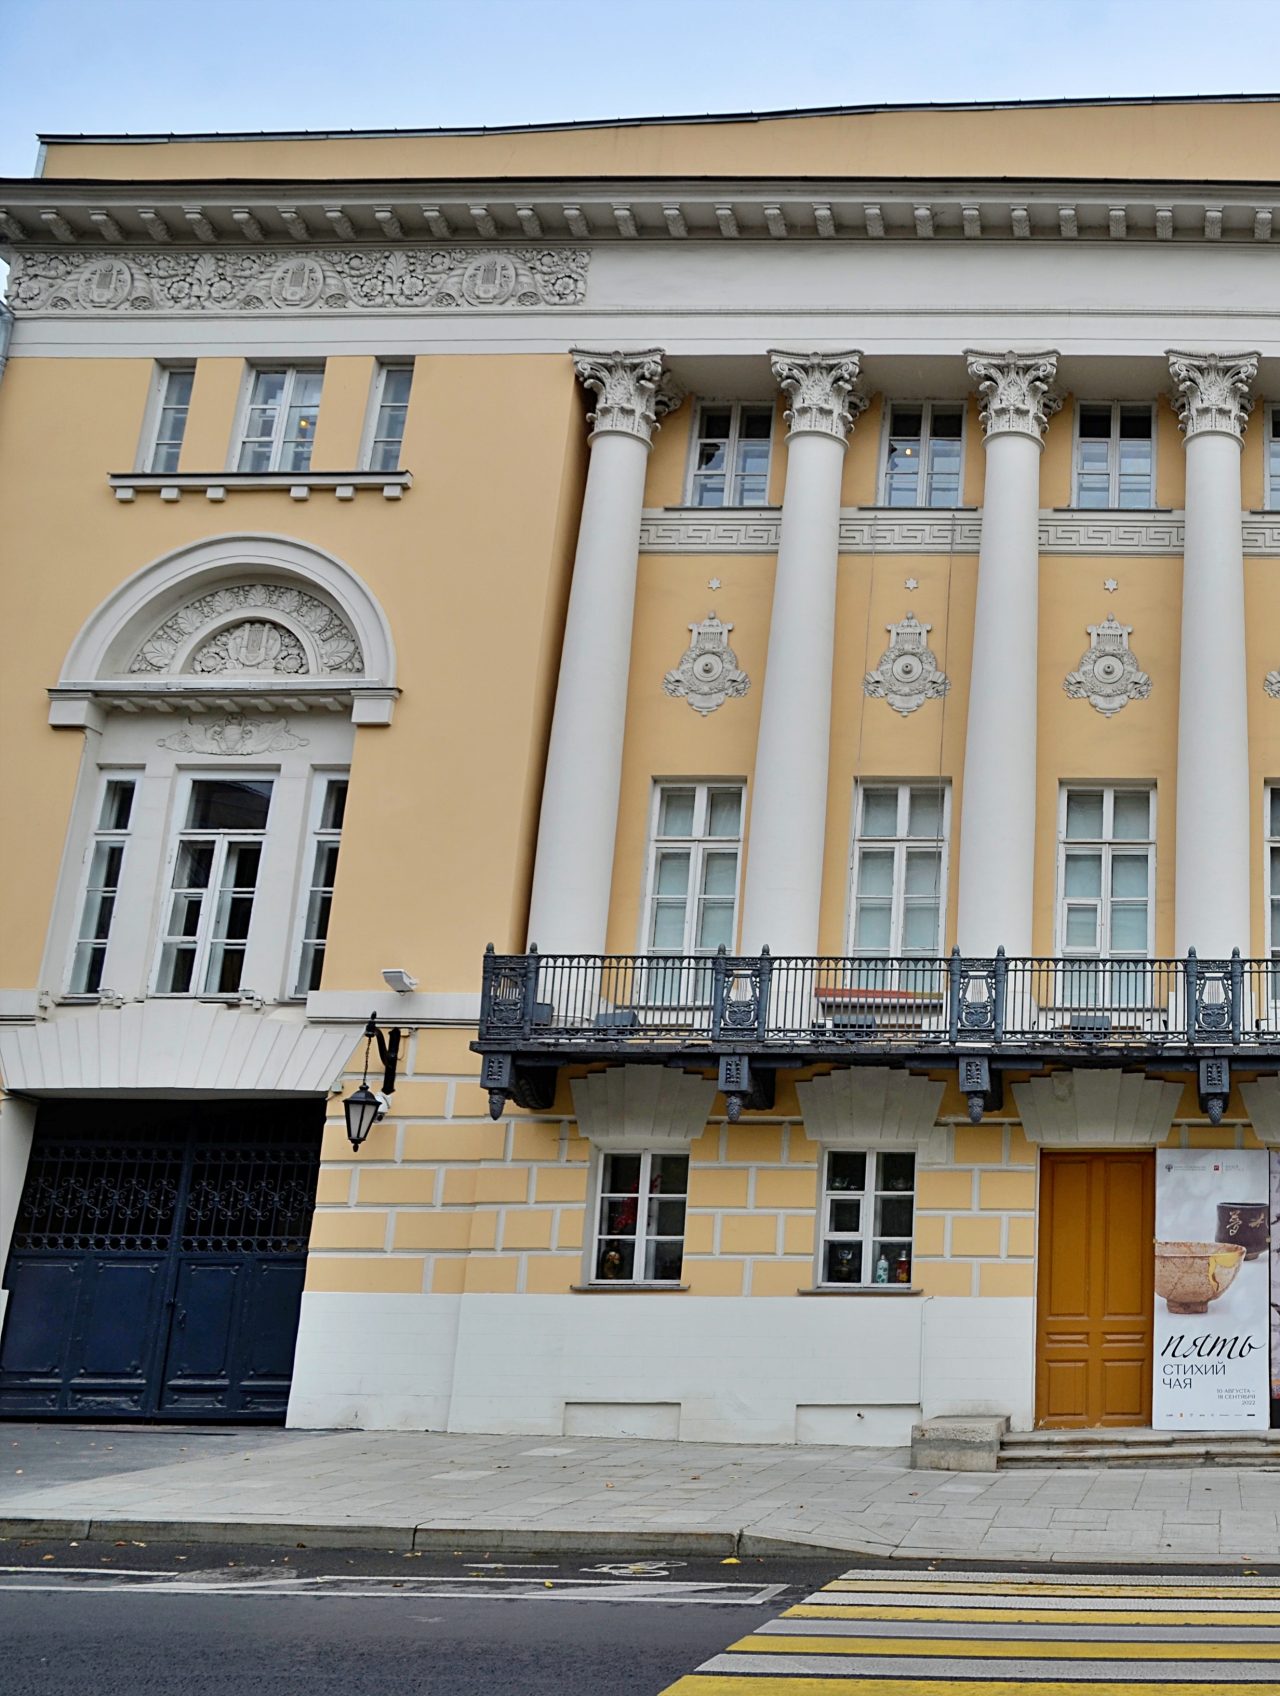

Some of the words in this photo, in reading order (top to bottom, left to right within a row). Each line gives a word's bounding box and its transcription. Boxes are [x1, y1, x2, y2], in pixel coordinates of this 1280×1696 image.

[1160, 1333, 1266, 1359] пять
[1162, 1361, 1226, 1376] СТИХИЙ
[1162, 1378, 1192, 1389] ЧАЯ
